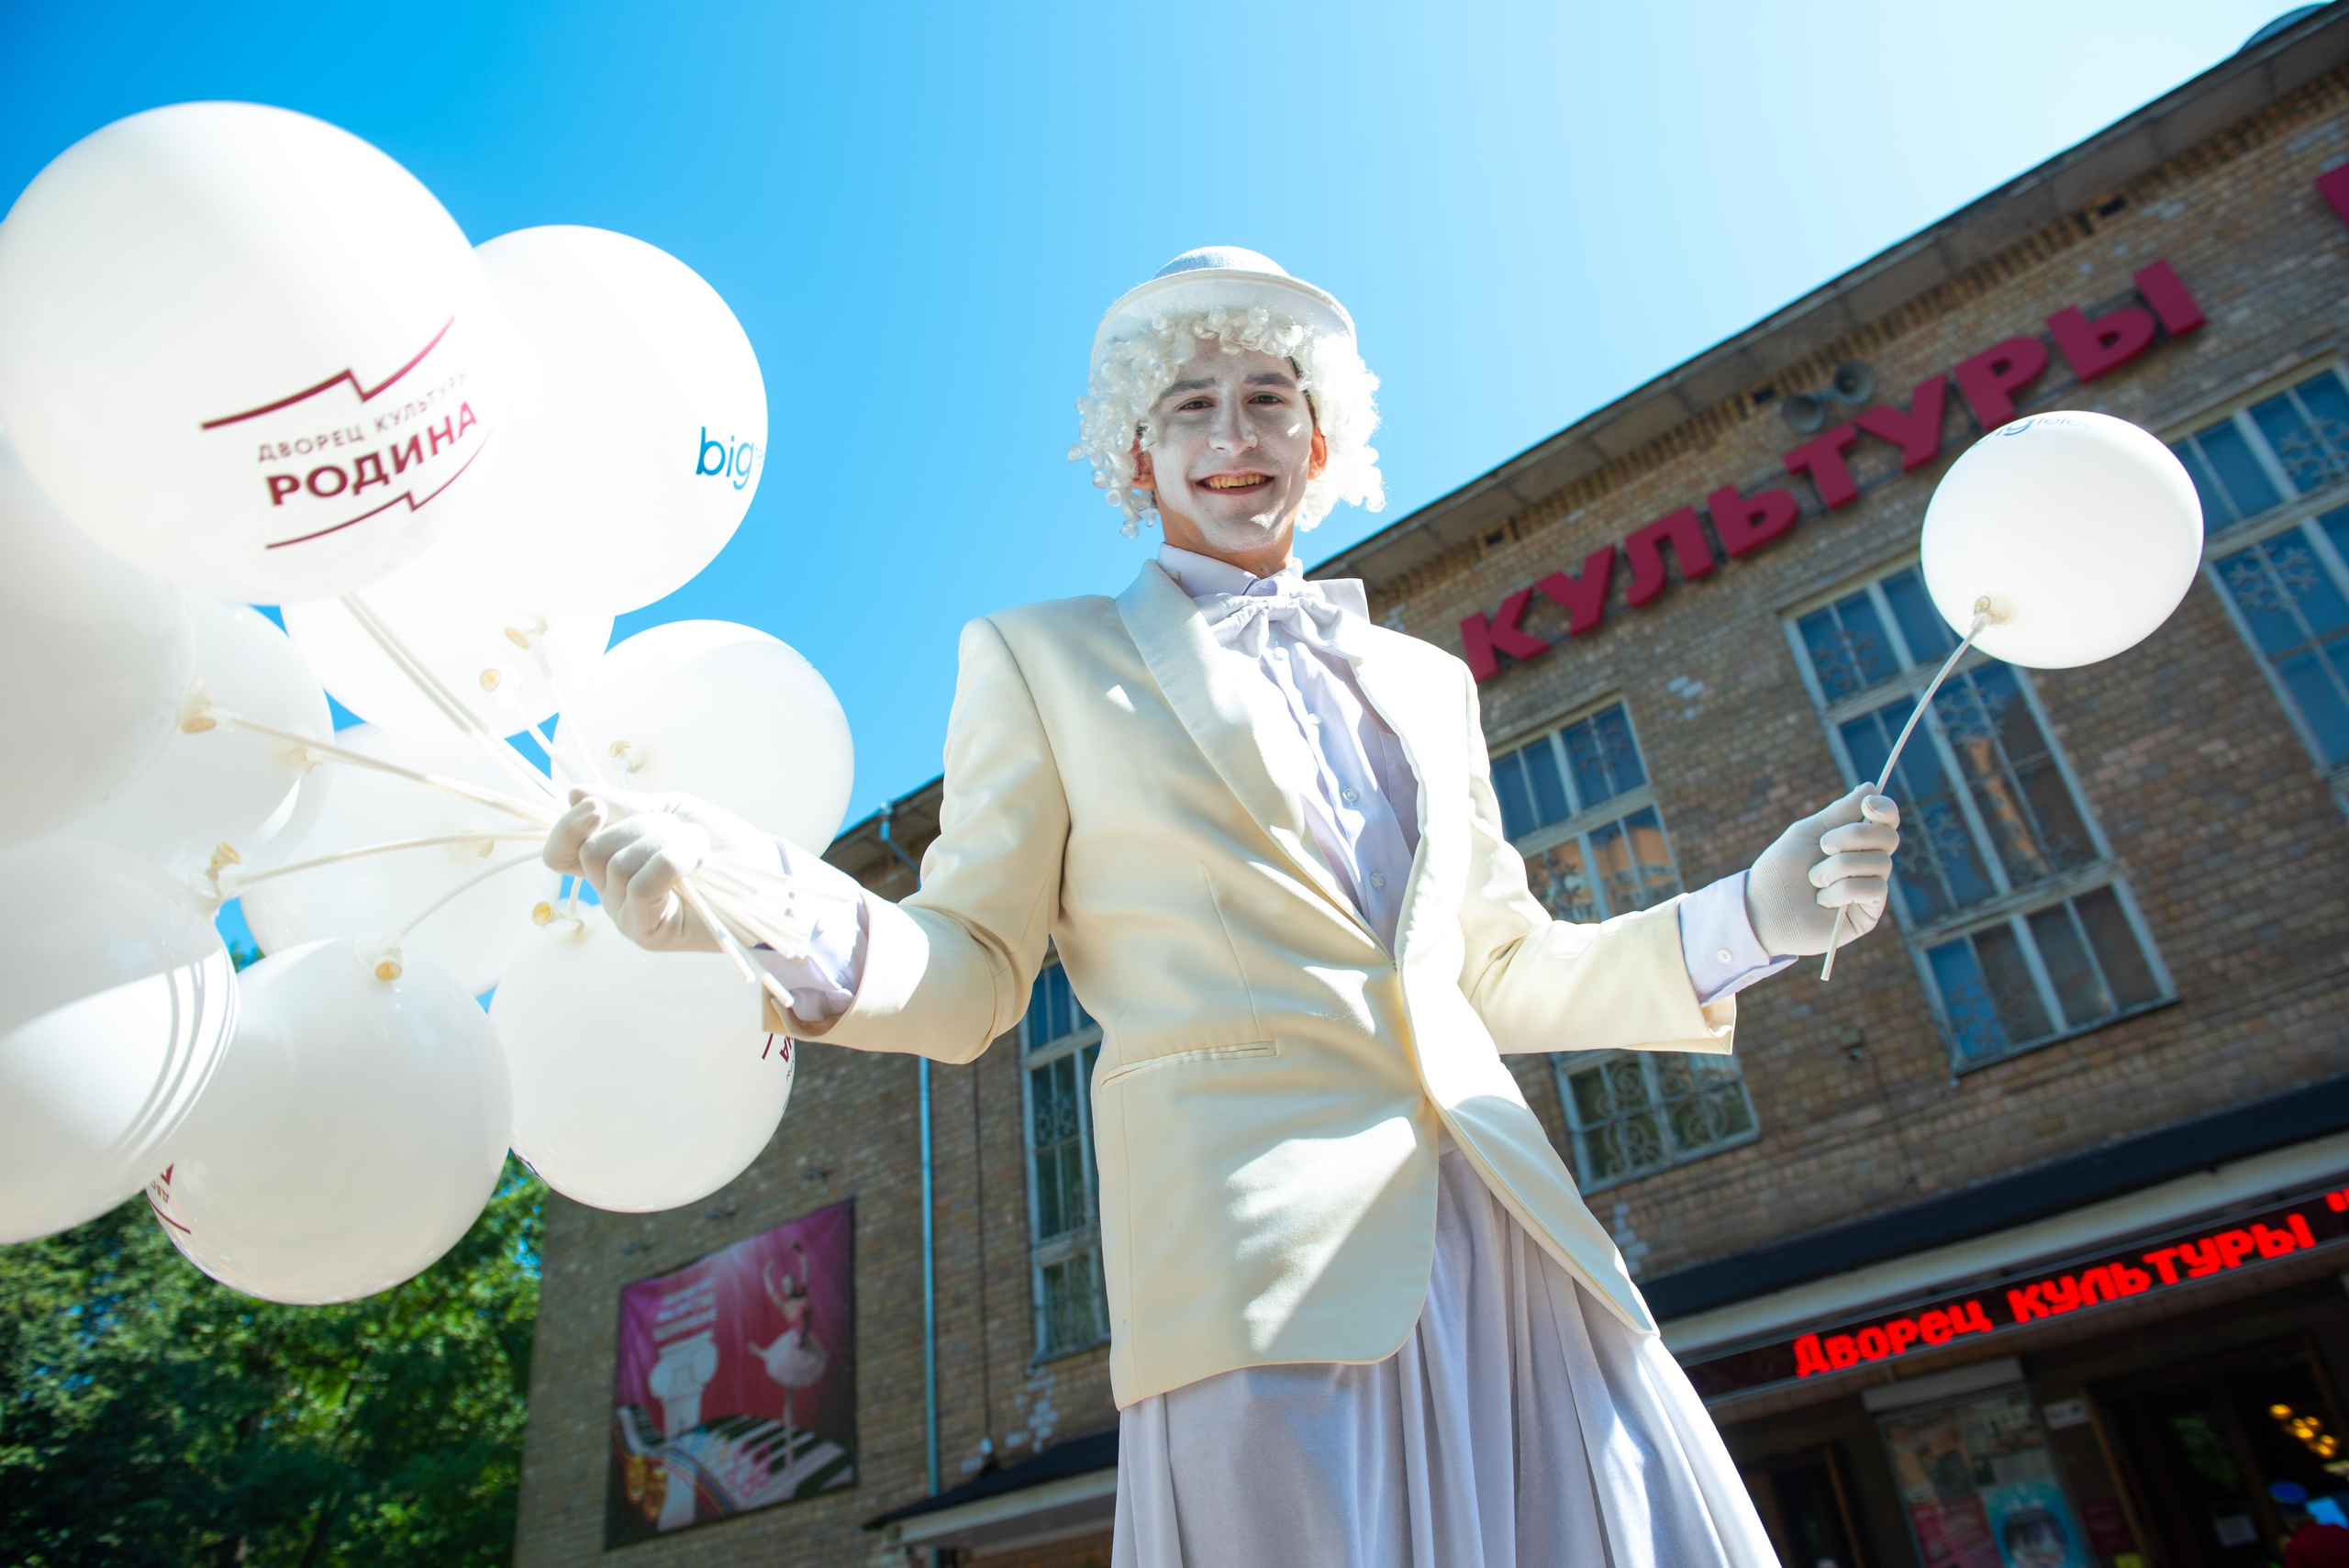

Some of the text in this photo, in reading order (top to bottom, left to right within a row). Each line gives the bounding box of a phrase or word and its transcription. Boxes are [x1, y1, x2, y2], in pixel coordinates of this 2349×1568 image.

[258, 424, 365, 463] ДВОРЕЦ
[265, 401, 477, 506] РОДИНА
[696, 427, 760, 491] big
[1459, 259, 2206, 683] КУЛЬТУРЫ
[1793, 1300, 1993, 1377] Дворец
